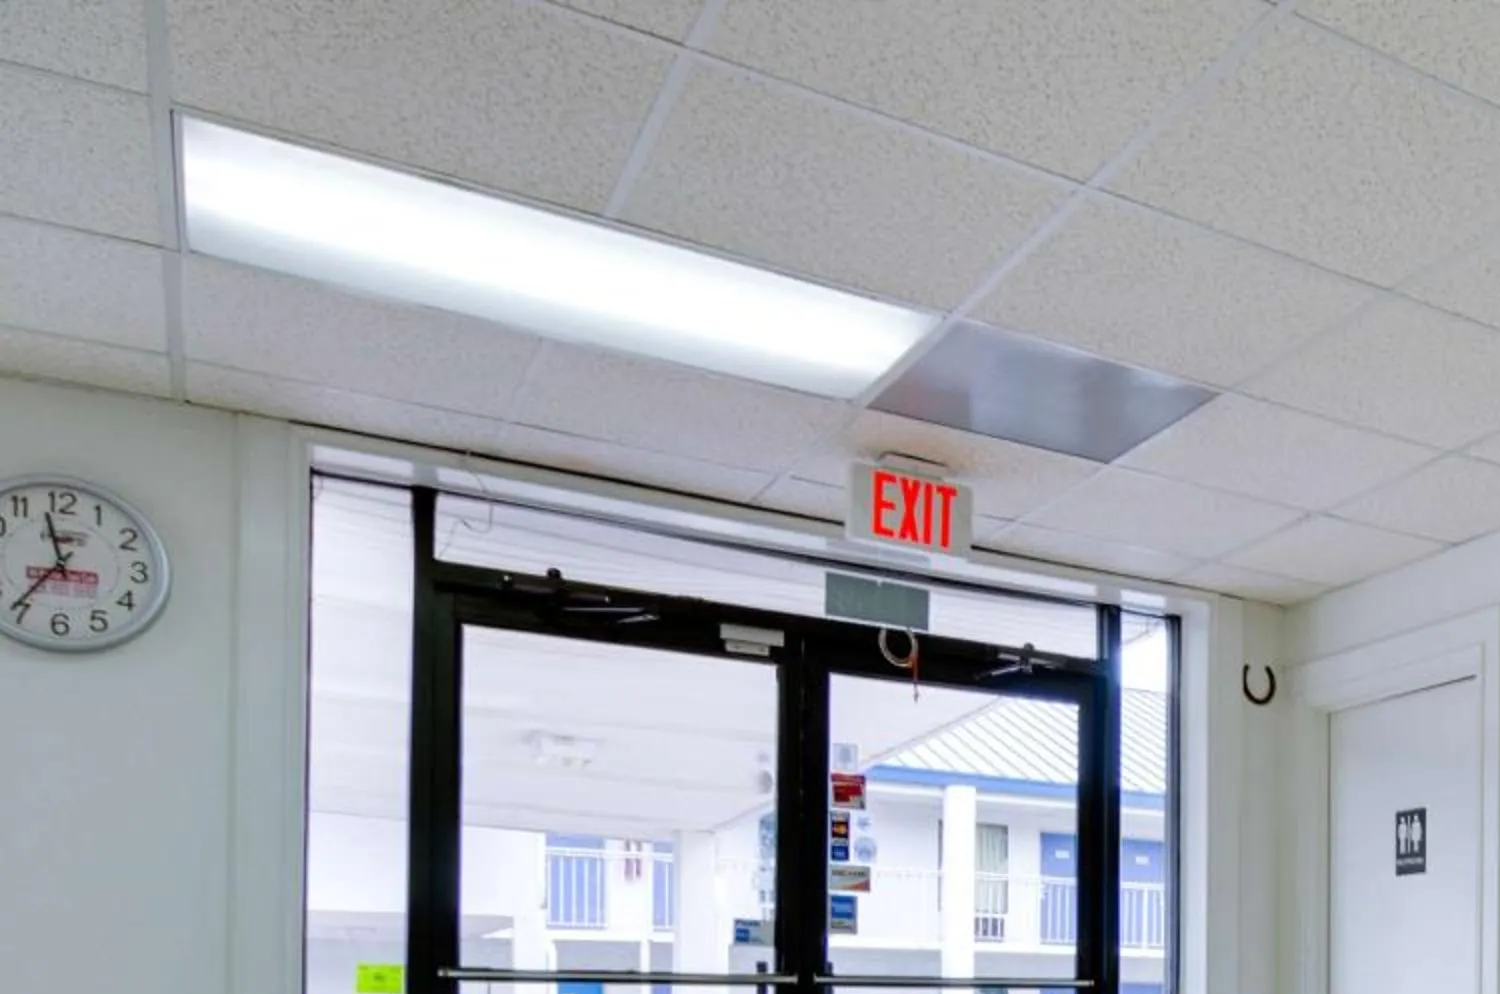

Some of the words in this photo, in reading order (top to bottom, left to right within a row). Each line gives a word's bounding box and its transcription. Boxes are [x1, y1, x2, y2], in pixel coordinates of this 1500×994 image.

[47, 490, 78, 515] 12
[873, 470, 958, 549] EXIT
[118, 528, 139, 551] 2
[130, 561, 148, 584] 3
[116, 590, 136, 611] 4
[50, 613, 70, 636] 6
[89, 609, 109, 633] 5
